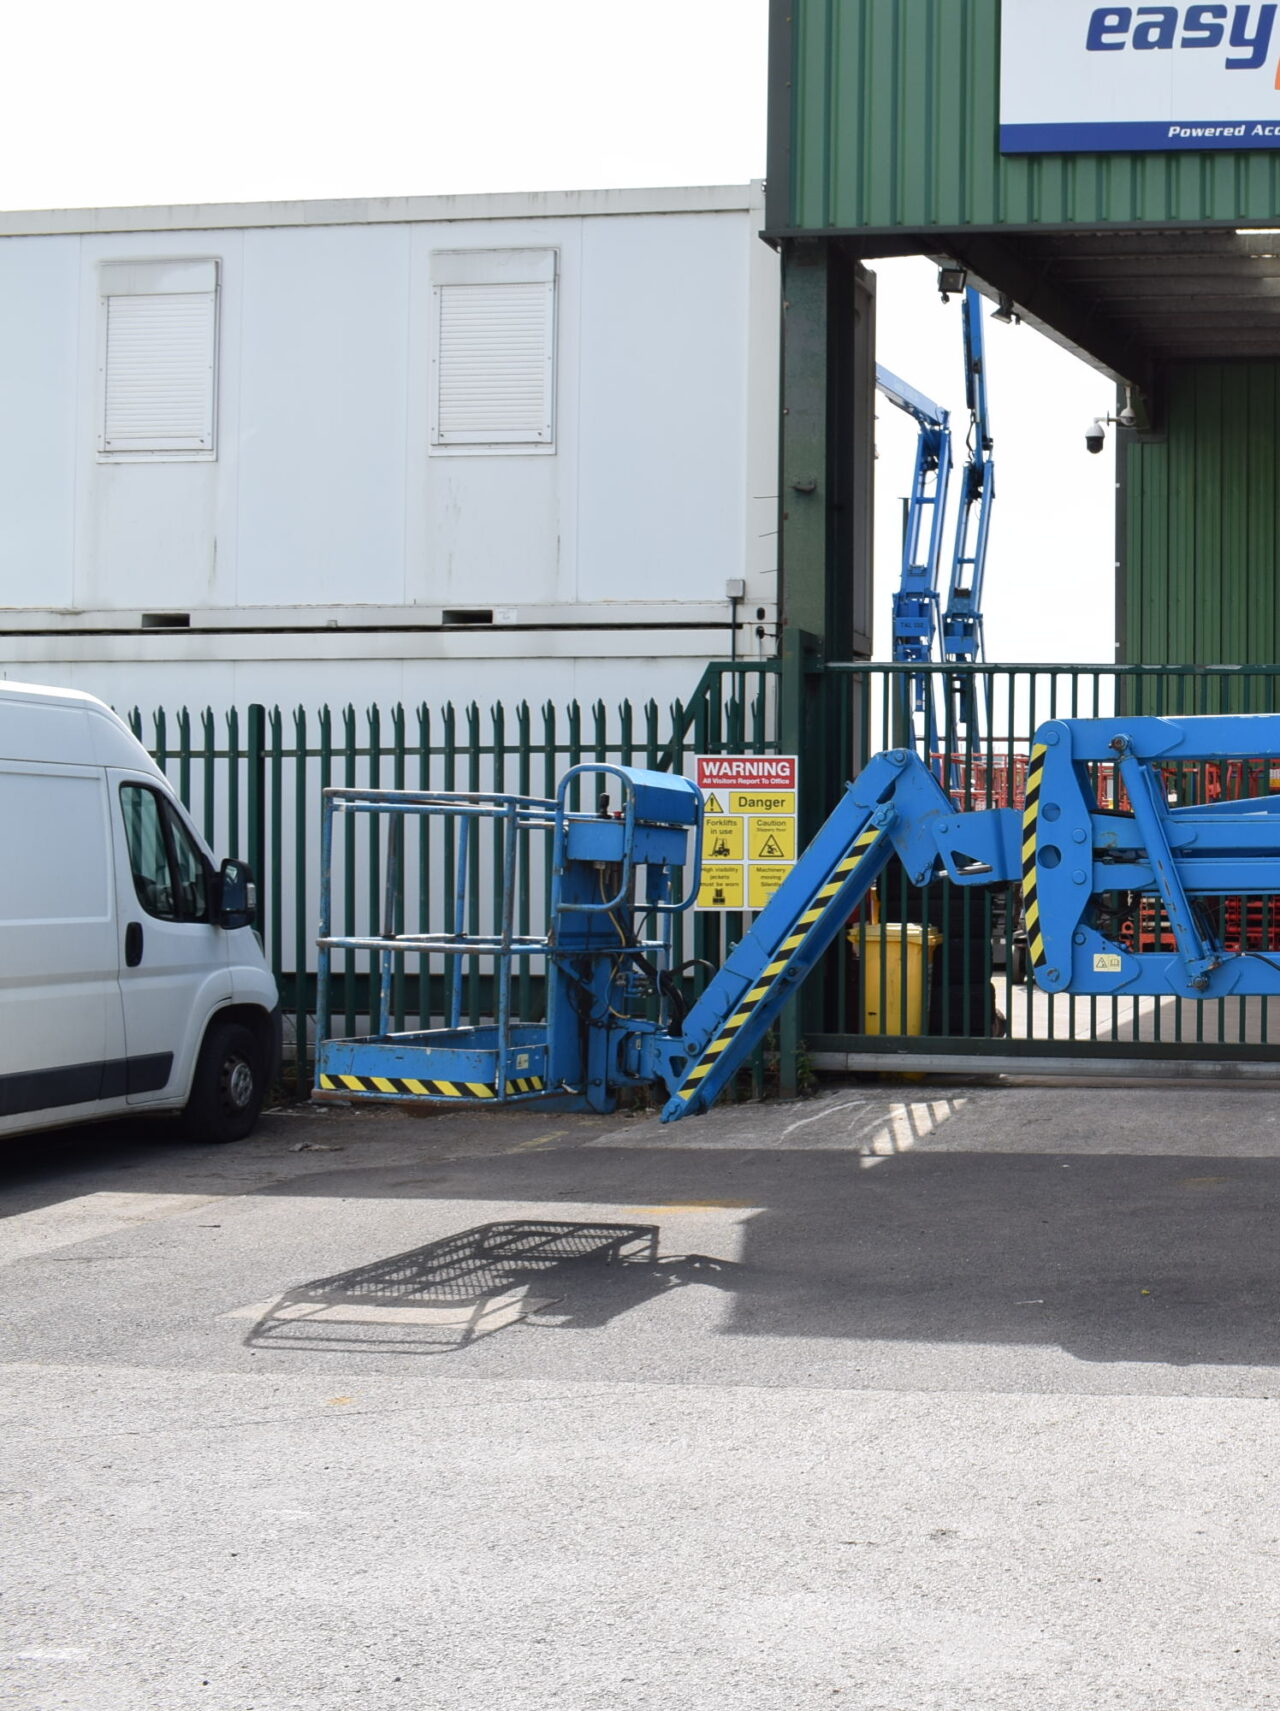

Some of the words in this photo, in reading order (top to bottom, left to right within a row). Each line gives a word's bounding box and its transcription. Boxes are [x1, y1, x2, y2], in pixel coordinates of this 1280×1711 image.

[1168, 124, 1246, 138] Powered
[702, 761, 790, 776] WARNING
[738, 778, 760, 786] Report
[738, 796, 786, 811] Danger
[756, 819, 787, 827] Caution
